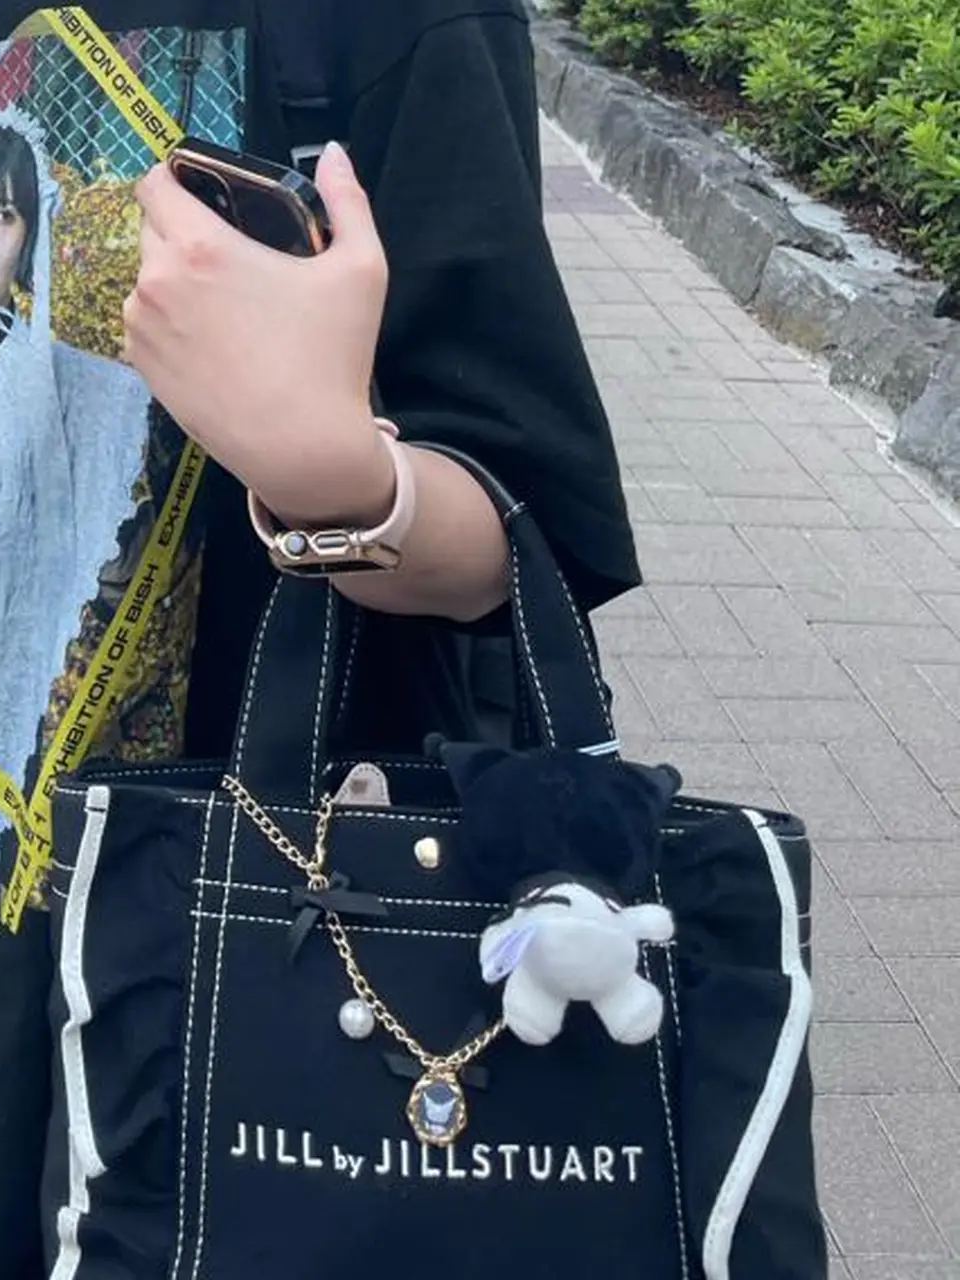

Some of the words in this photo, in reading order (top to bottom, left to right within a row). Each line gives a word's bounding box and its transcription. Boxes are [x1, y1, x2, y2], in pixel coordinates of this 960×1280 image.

[112, 73, 137, 99] OF
[107, 628, 130, 661] OF
[230, 1122, 323, 1168] JILL
[333, 1145, 365, 1179] by
[374, 1137, 644, 1183] JILLSTUART
